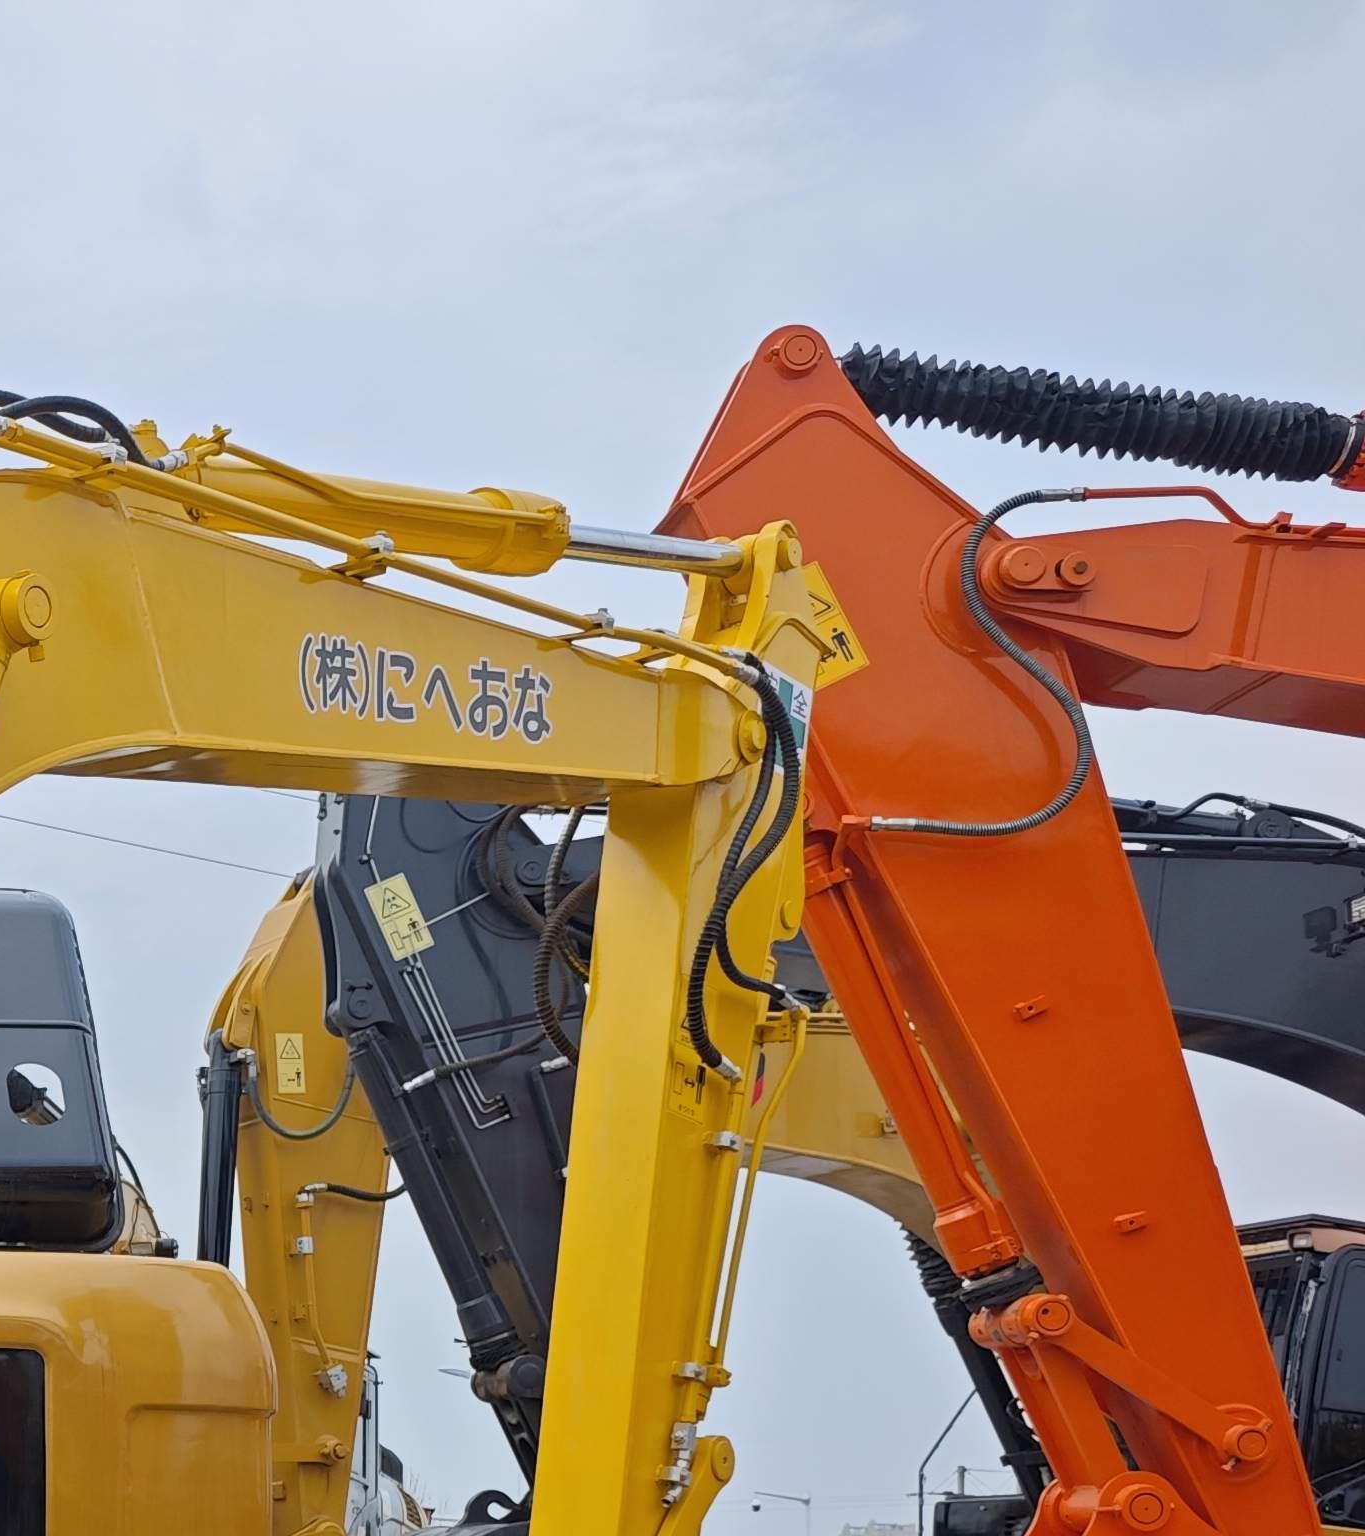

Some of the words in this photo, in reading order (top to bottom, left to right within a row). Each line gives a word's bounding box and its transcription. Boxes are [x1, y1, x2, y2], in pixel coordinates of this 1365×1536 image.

[301, 634, 552, 743] (株)にへおな
